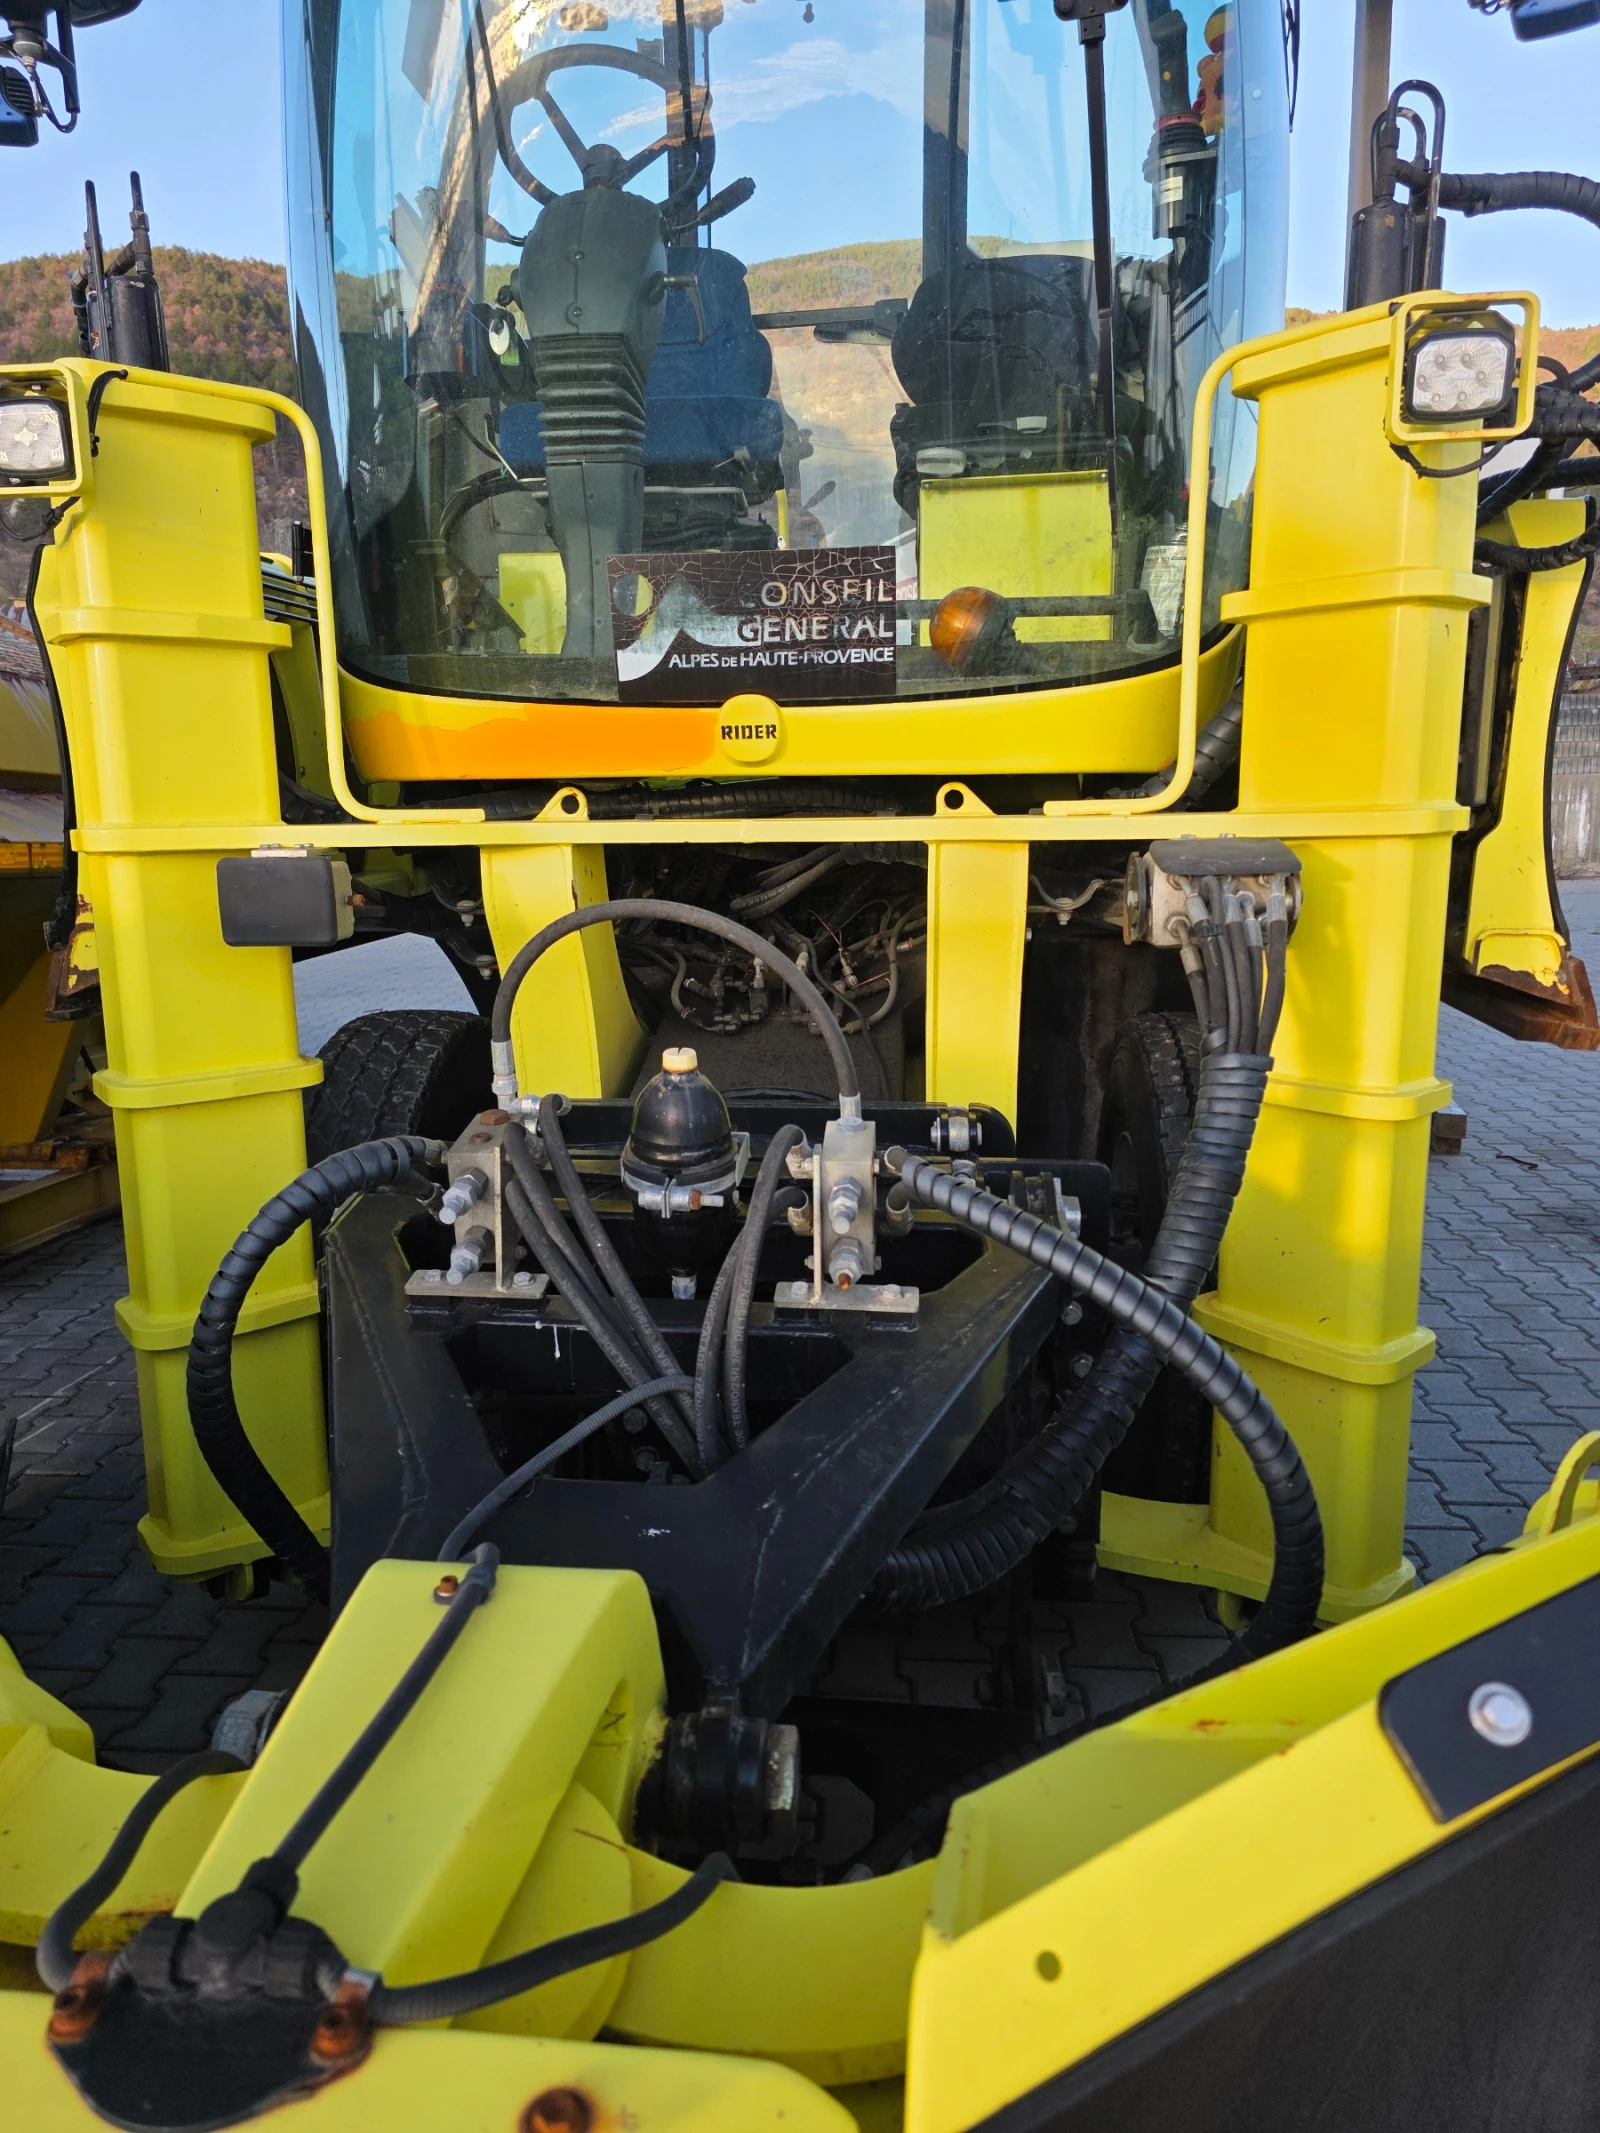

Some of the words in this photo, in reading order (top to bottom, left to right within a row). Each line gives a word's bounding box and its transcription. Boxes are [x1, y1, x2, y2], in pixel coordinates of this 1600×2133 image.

[668, 652, 720, 668] ALPES
[739, 646, 894, 667] HAUTE-PROVENCE
[721, 724, 777, 740] RIDER
